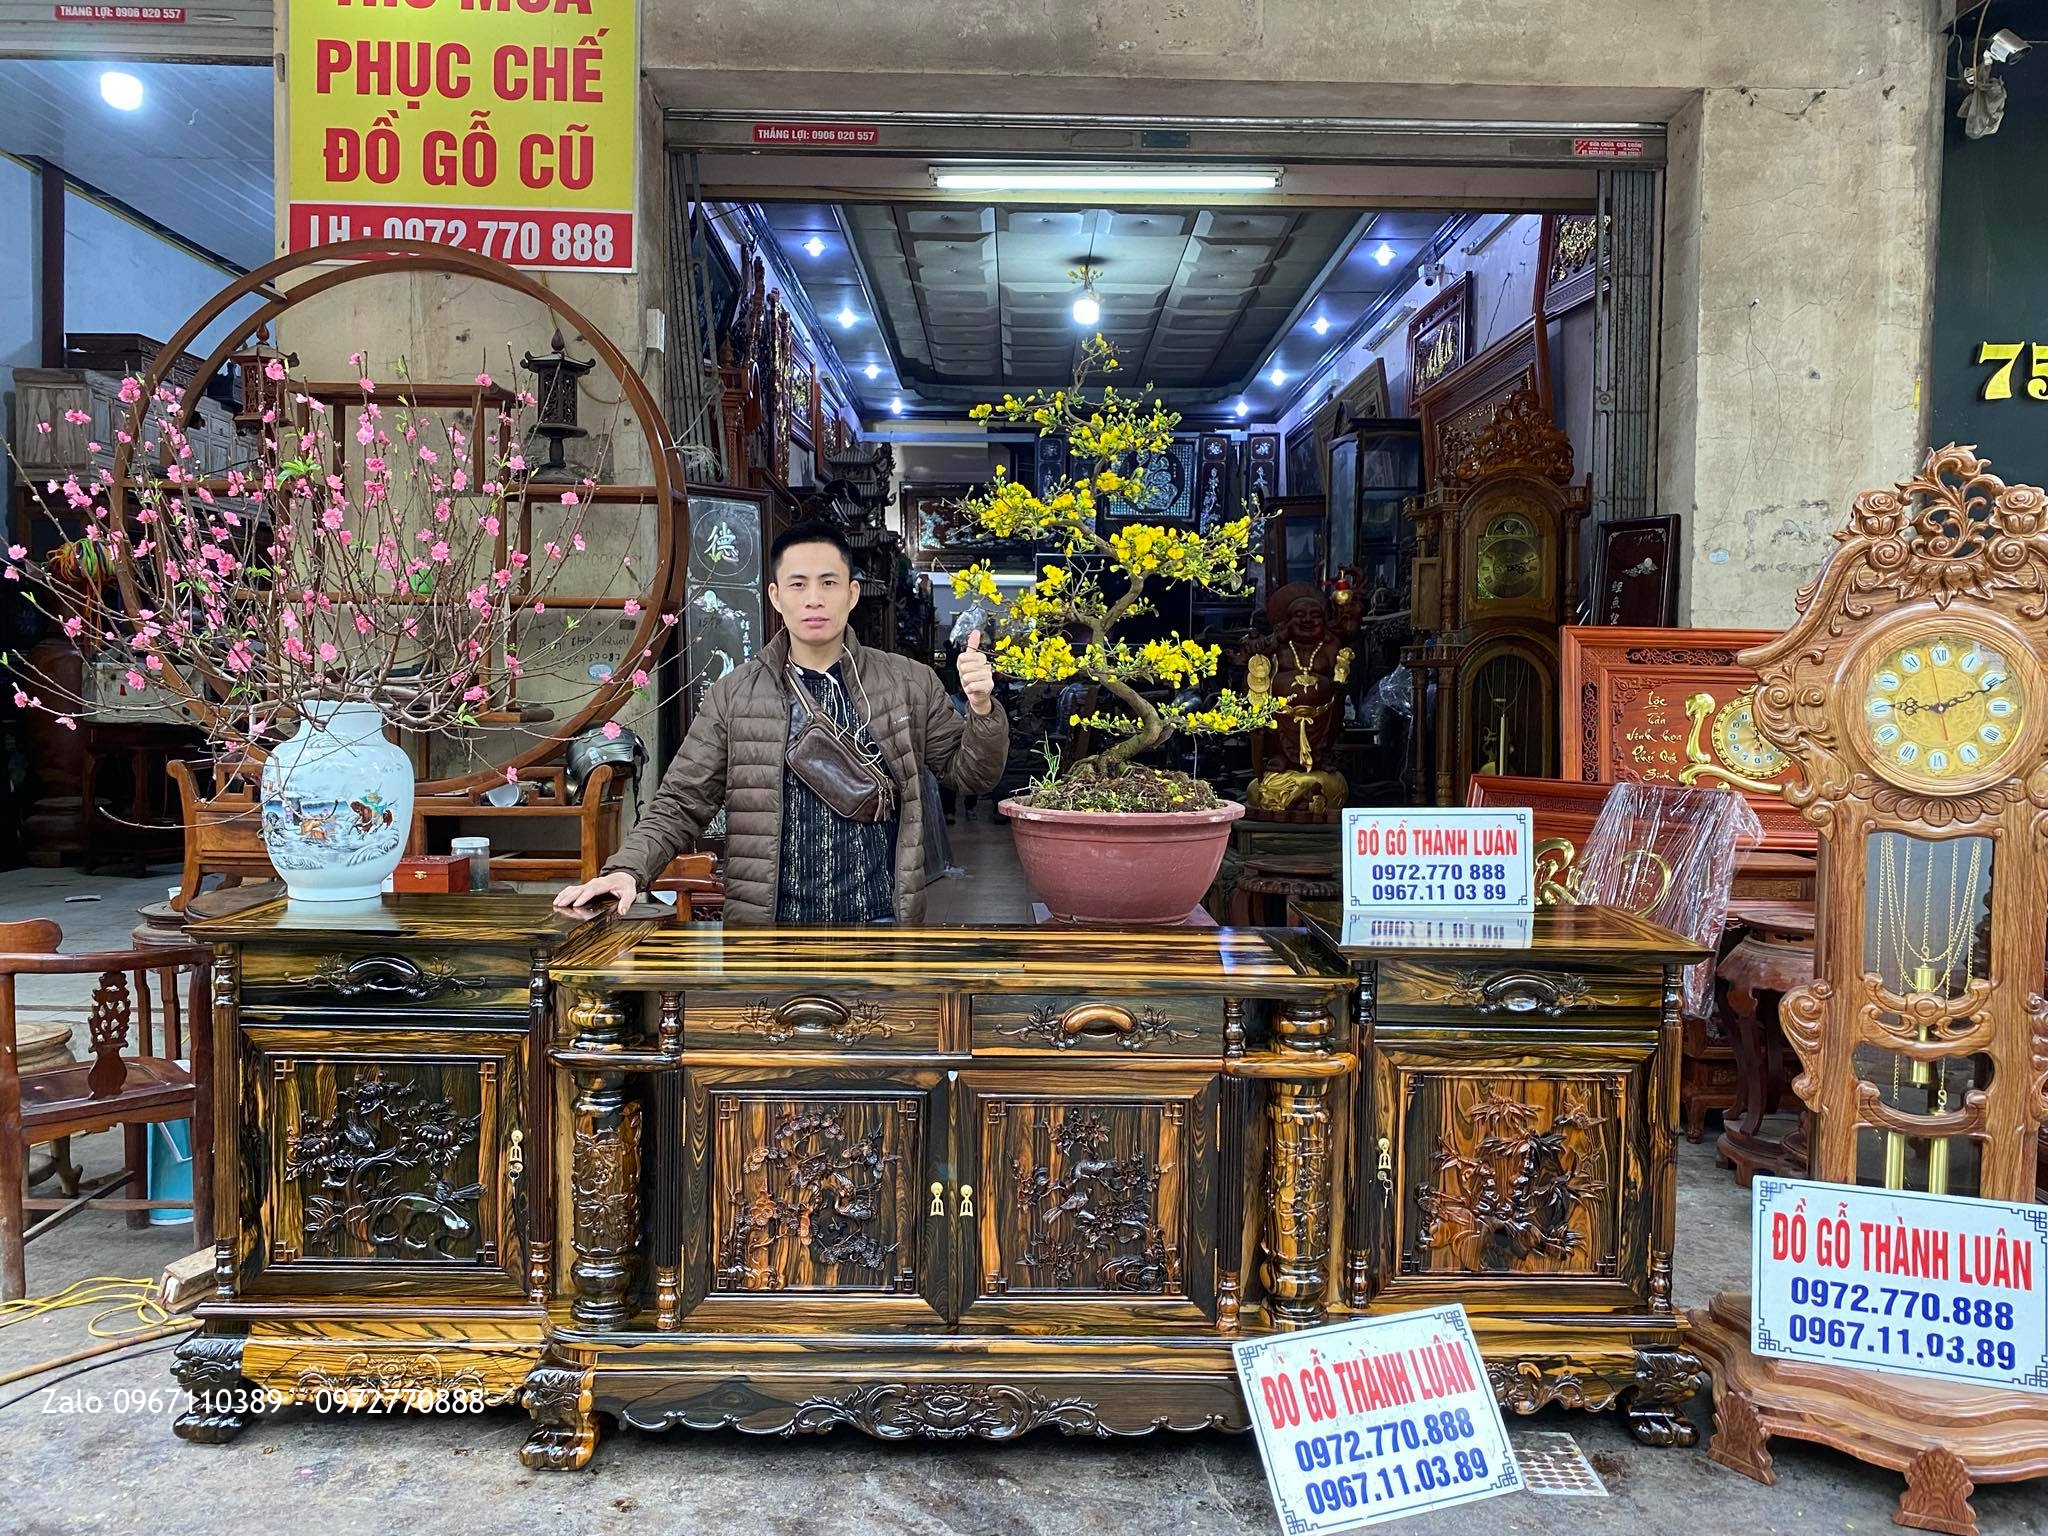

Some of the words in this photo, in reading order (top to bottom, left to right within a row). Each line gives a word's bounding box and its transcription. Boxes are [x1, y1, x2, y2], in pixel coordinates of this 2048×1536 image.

[163, 9, 181, 19] 557
[317, 39, 470, 109] PHỤC
[494, 28, 609, 103] CHẾ
[323, 110, 400, 183] ĐỒ
[423, 110, 497, 187] GỖ
[519, 124, 594, 190] CŨ
[812, 130, 835, 140] 0906
[837, 131, 855, 140] 020
[857, 131, 875, 141] 557
[552, 223, 614, 262] 888
[1357, 821, 1379, 856] ĐỒ
[1385, 820, 1408, 856] GỖ
[1412, 824, 1468, 856] THÀNH
[1474, 824, 1518, 856] LUÂN
[1372, 864, 1463, 880] 0972.770
[1469, 864, 1506, 880] 888
[1372, 884, 1445, 900] 0967.11
[1454, 884, 1477, 900] 03
[1483, 884, 1506, 900] 89
[1772, 1198, 1807, 1264] ĐỒ
[1816, 1201, 1851, 1269] GỖ
[1859, 1216, 1949, 1281] THÀNH
[1959, 1227, 2033, 1291] LUÂN
[1791, 1276, 2014, 1331] 0972.770.888
[1789, 1313, 2016, 1371] 0967.11.03.89
[1300, 1348, 1337, 1423] GỖ
[1333, 1349, 1416, 1416] THÀNH
[1408, 1334, 1477, 1401] LUÂN
[1295, 1407, 1475, 1472] 0972.770.888
[1305, 1447, 1489, 1515] 0967.11.03.89
